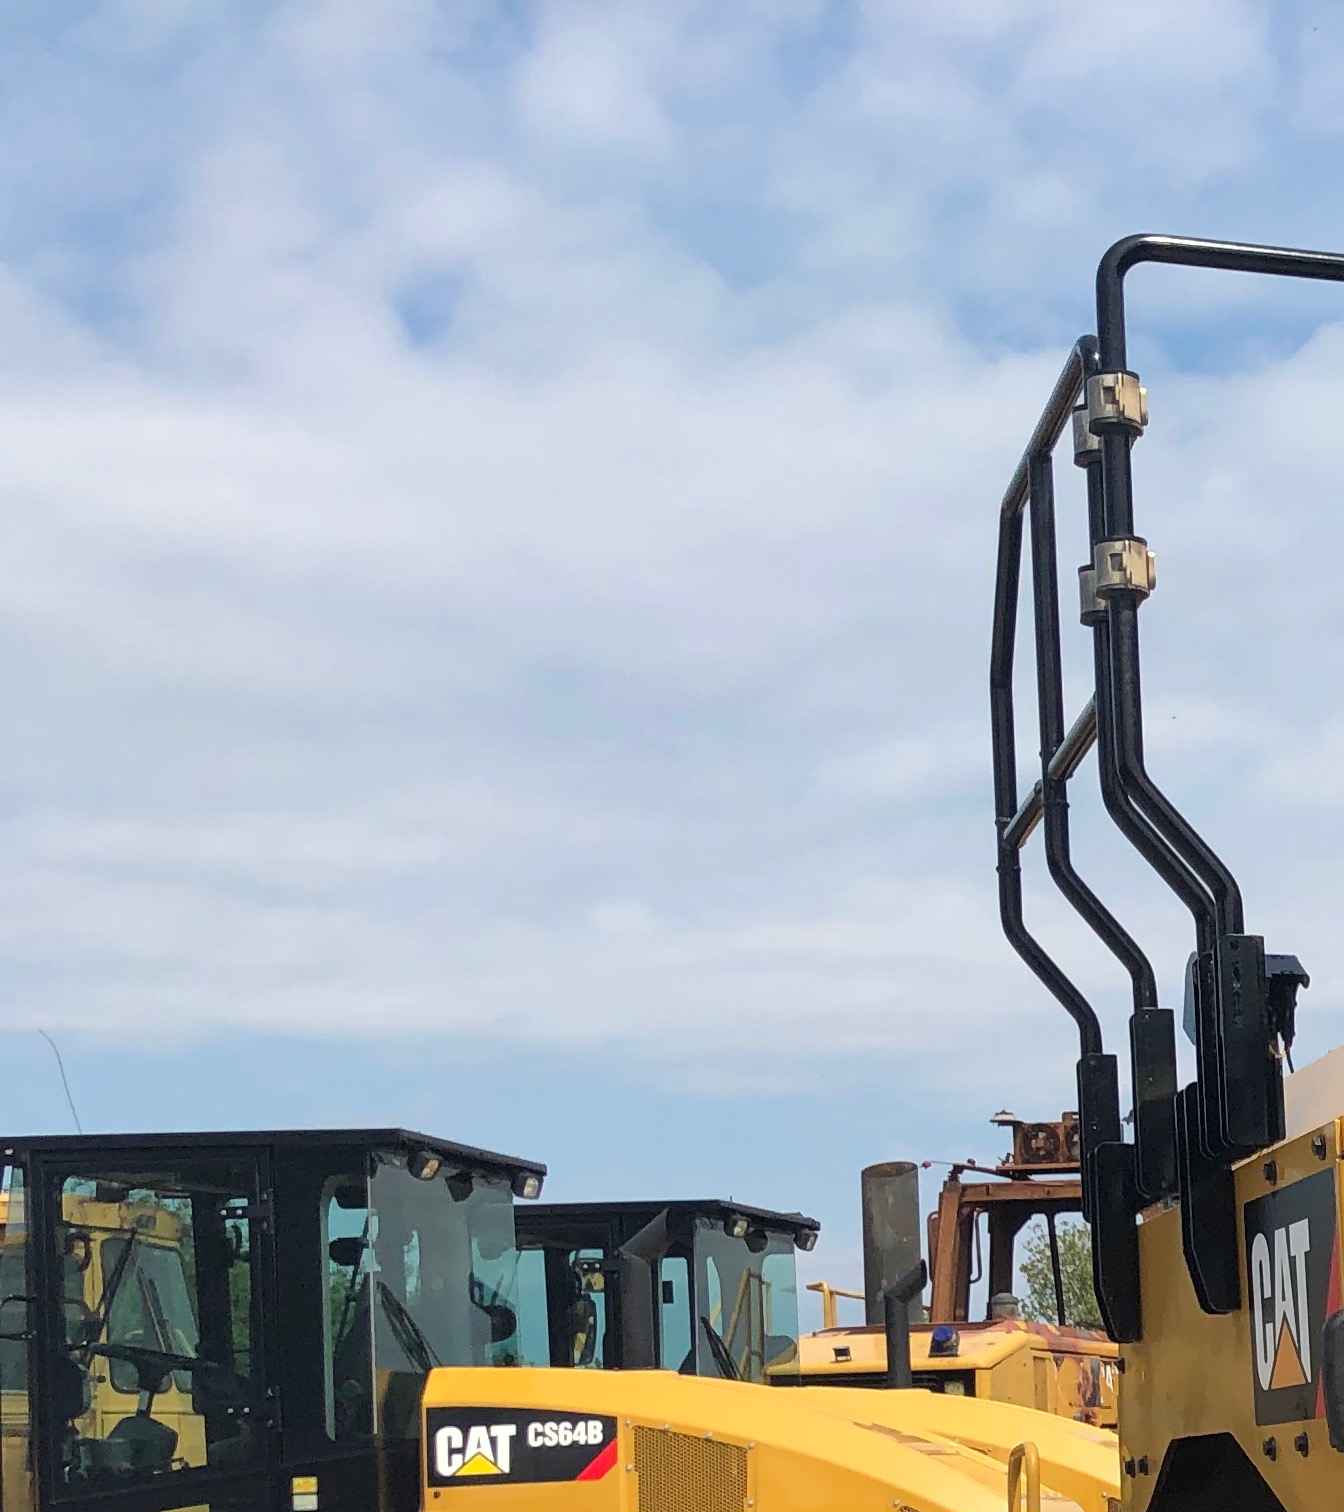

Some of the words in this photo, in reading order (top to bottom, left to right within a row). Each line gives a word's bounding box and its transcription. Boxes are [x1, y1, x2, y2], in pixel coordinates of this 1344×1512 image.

[1251, 1217, 1312, 1391] CAT
[434, 1423, 517, 1477] CAT
[527, 1419, 605, 1448] CS64B
